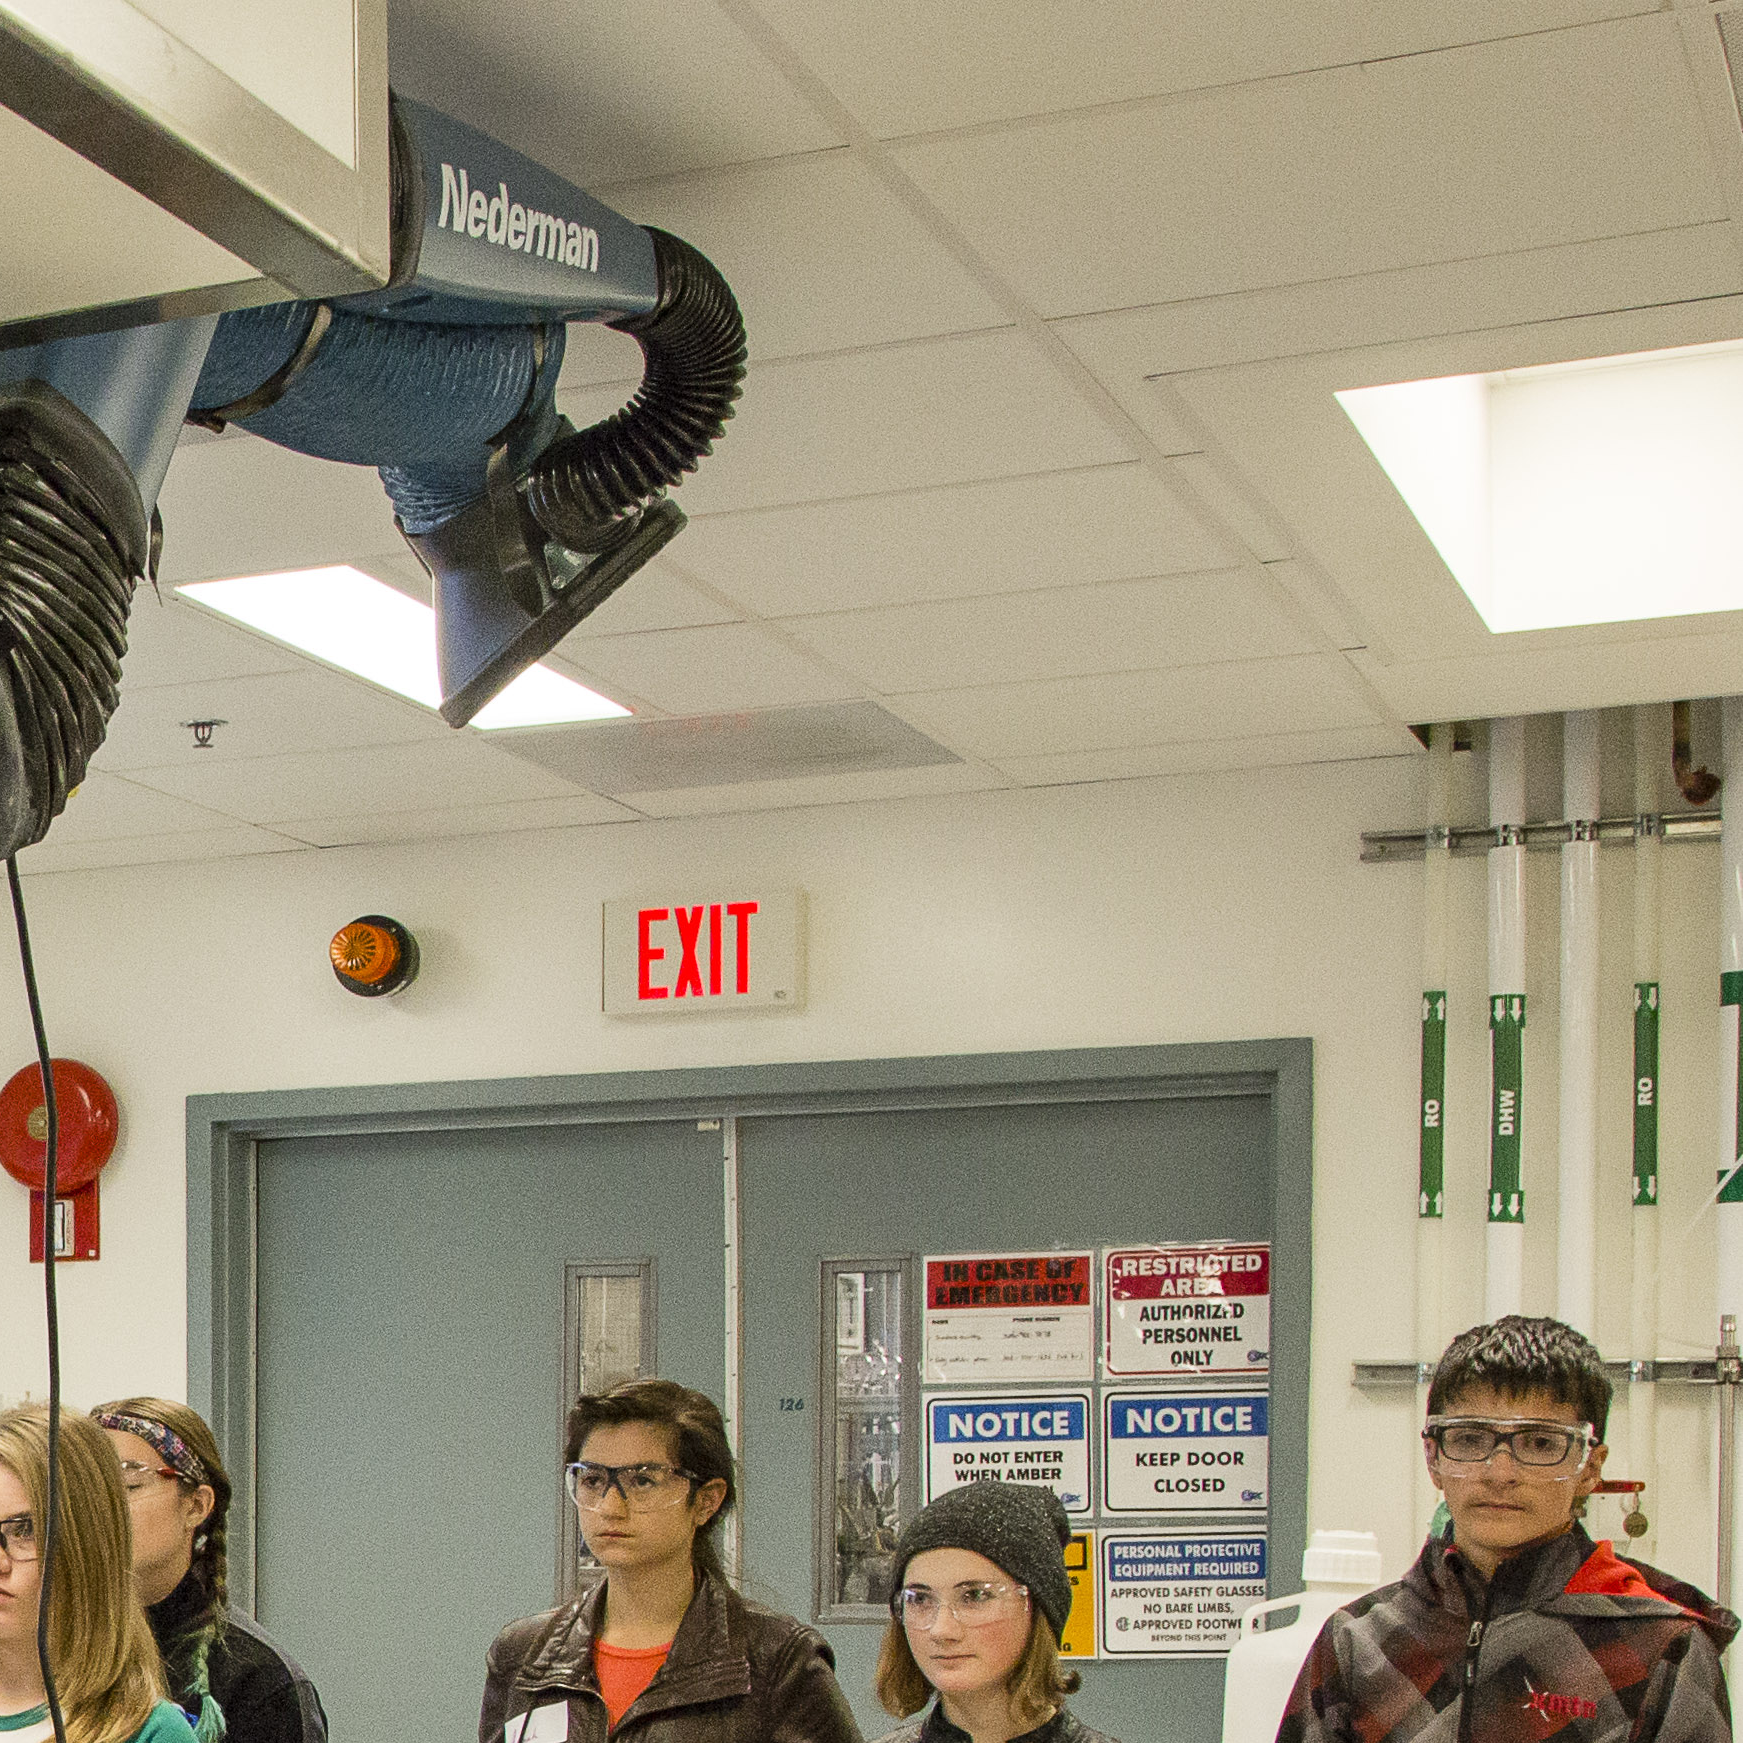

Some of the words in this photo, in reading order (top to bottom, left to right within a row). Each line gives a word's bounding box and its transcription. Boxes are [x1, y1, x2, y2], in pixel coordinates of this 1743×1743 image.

[437, 162, 599, 273] Nederman
[638, 901, 760, 1000] EXIT
[1638, 1077, 1653, 1106] RO
[1425, 1099, 1441, 1128] RO
[1498, 1090, 1515, 1136] DHW
[943, 1263, 969, 1282] IN
[975, 1260, 1040, 1281] CASE
[1046, 1259, 1077, 1279] OF
[1121, 1254, 1263, 1277] RESTRICTED
[935, 1283, 1085, 1305] EMERGENCY
[1161, 1278, 1225, 1296] AREA
[1142, 1326, 1243, 1344] PERSONNEL
[1170, 1350, 1214, 1366] ONLY
[948, 1411, 1070, 1439] NOTICE
[1126, 1406, 1253, 1433] NOTICE
[953, 1452, 975, 1465] DO
[979, 1451, 1009, 1464] NOT
[1014, 1450, 1063, 1463] ENTER
[1135, 1452, 1181, 1467] KEEP
[1187, 1452, 1244, 1466] DOOR
[955, 1469, 1001, 1482] WHEN
[1006, 1468, 1062, 1481] AMBER
[1154, 1478, 1226, 1493] CLOSED
[1114, 1545, 1182, 1559] PERSONAL
[1185, 1543, 1261, 1558] PROTECTIVE
[1114, 1563, 1190, 1577] EQUIPMENT
[1193, 1562, 1260, 1576] REQUIRED
[1110, 1587, 1170, 1599] APPROVED
[1172, 1587, 1213, 1598] SAFETY
[1216, 1586, 1264, 1597] GLASSES
[1143, 1604, 1162, 1614] NO
[1165, 1603, 1194, 1613] BARE
[1133, 1619, 1193, 1630] APPROVED
[1196, 1618, 1259, 1630] FOOTWER
[1184, 1634, 1201, 1642] THIS
[1202, 1633, 1227, 1642] POINT
